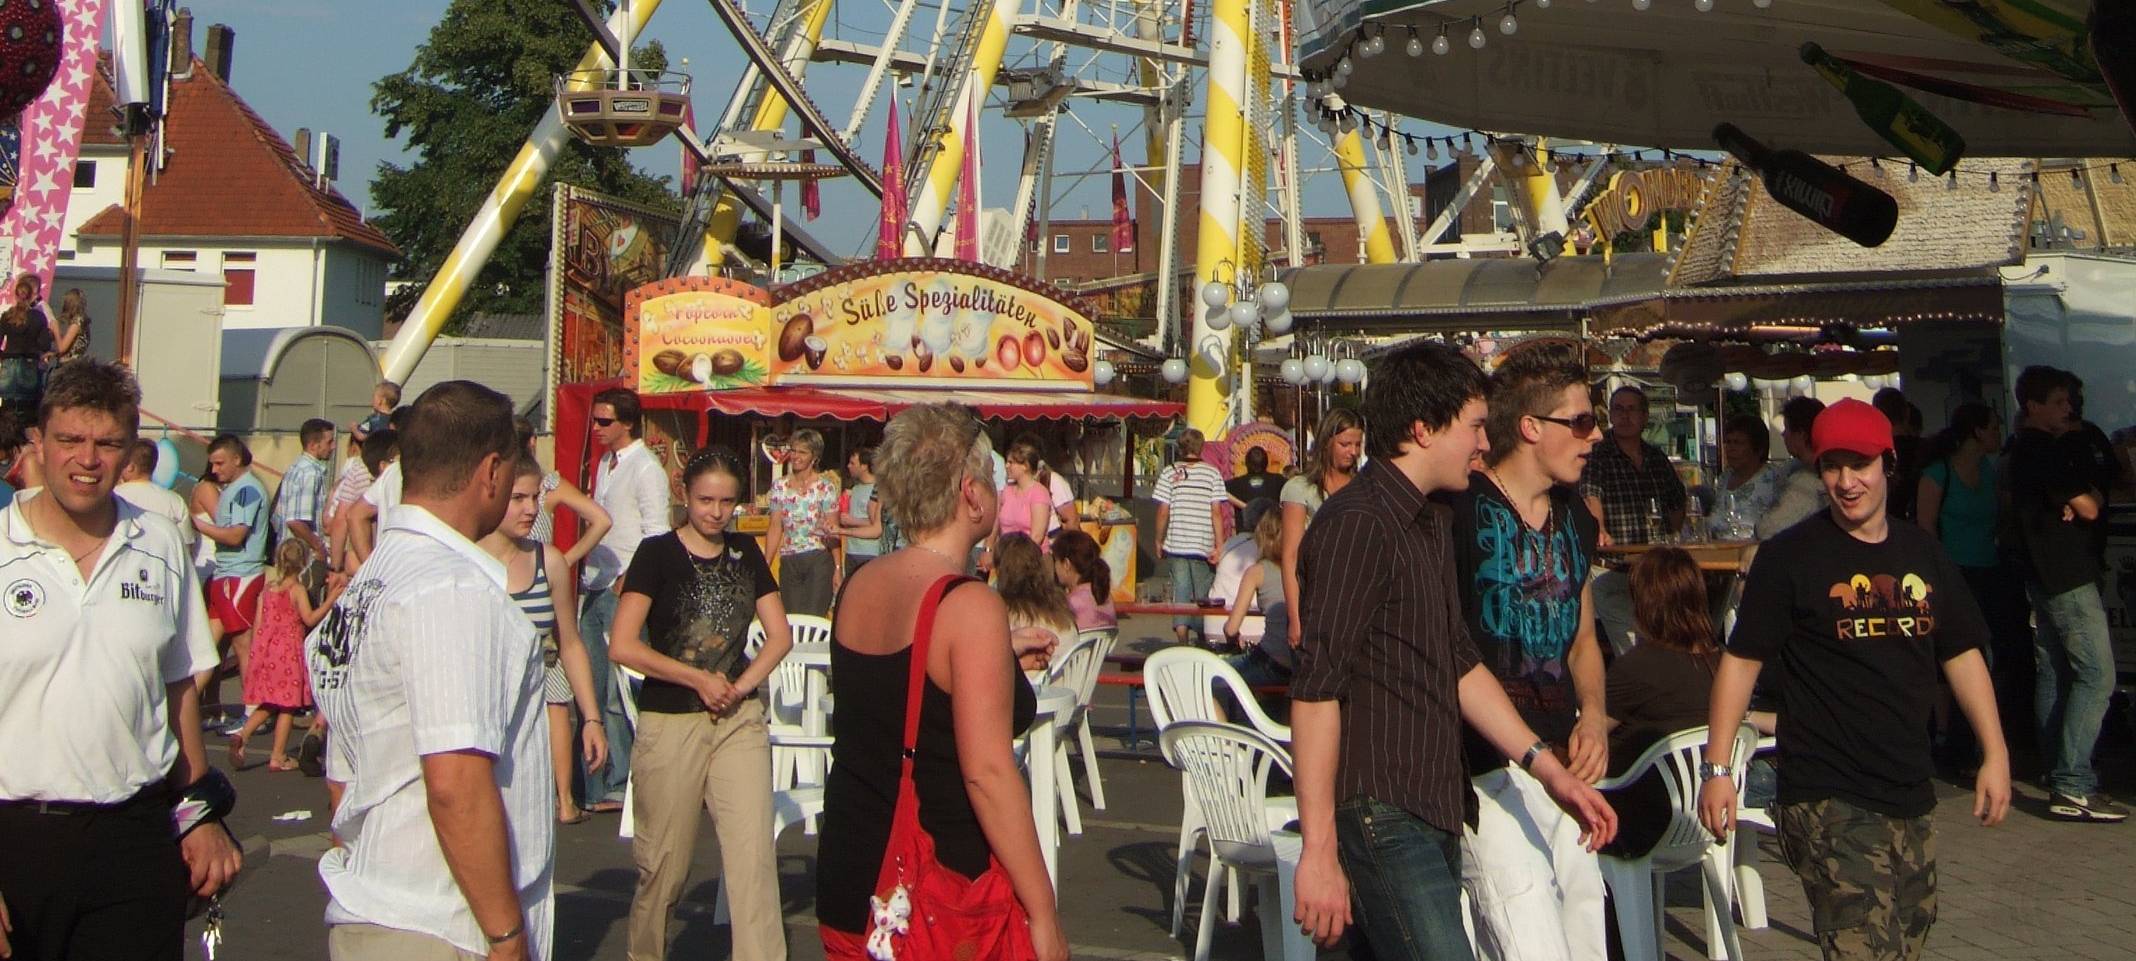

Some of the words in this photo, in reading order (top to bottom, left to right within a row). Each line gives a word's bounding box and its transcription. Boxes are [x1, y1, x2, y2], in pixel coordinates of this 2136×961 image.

[842, 288, 898, 326] Süße
[904, 281, 1037, 328] Spezialitäten
[121, 582, 164, 605] Bitburger
